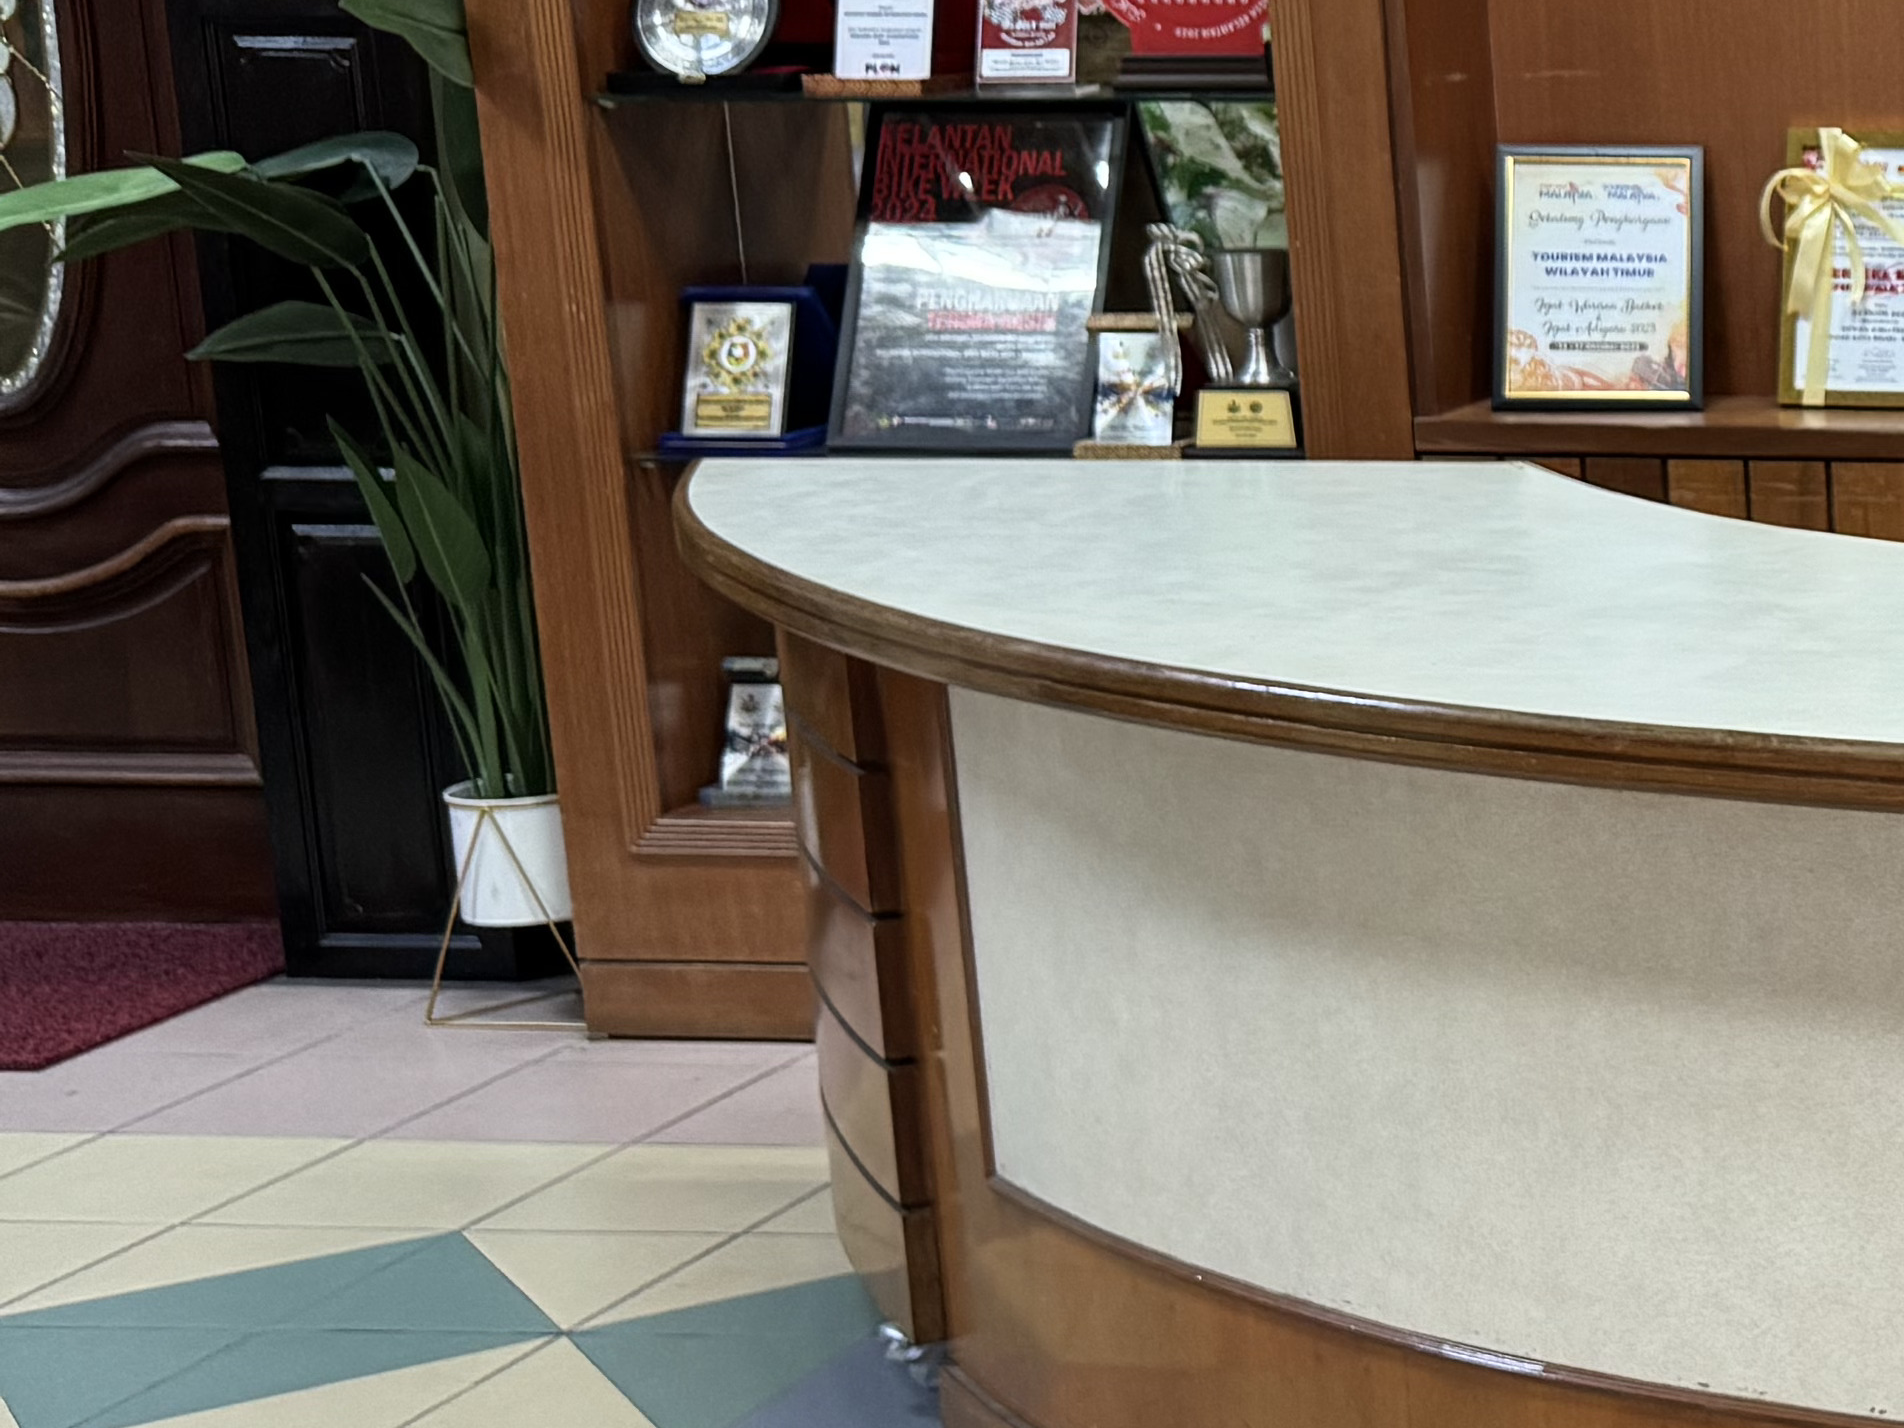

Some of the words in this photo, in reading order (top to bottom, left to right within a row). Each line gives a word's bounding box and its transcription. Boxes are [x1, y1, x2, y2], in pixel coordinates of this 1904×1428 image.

[878, 124, 1014, 152] KELANTAN
[876, 149, 1066, 176] INTERNATIONAL
[873, 174, 935, 200] BIKE
[939, 174, 1015, 201] WEK
[1532, 252, 1594, 262] TOURISM
[1596, 252, 1668, 263] MALAYSIA
